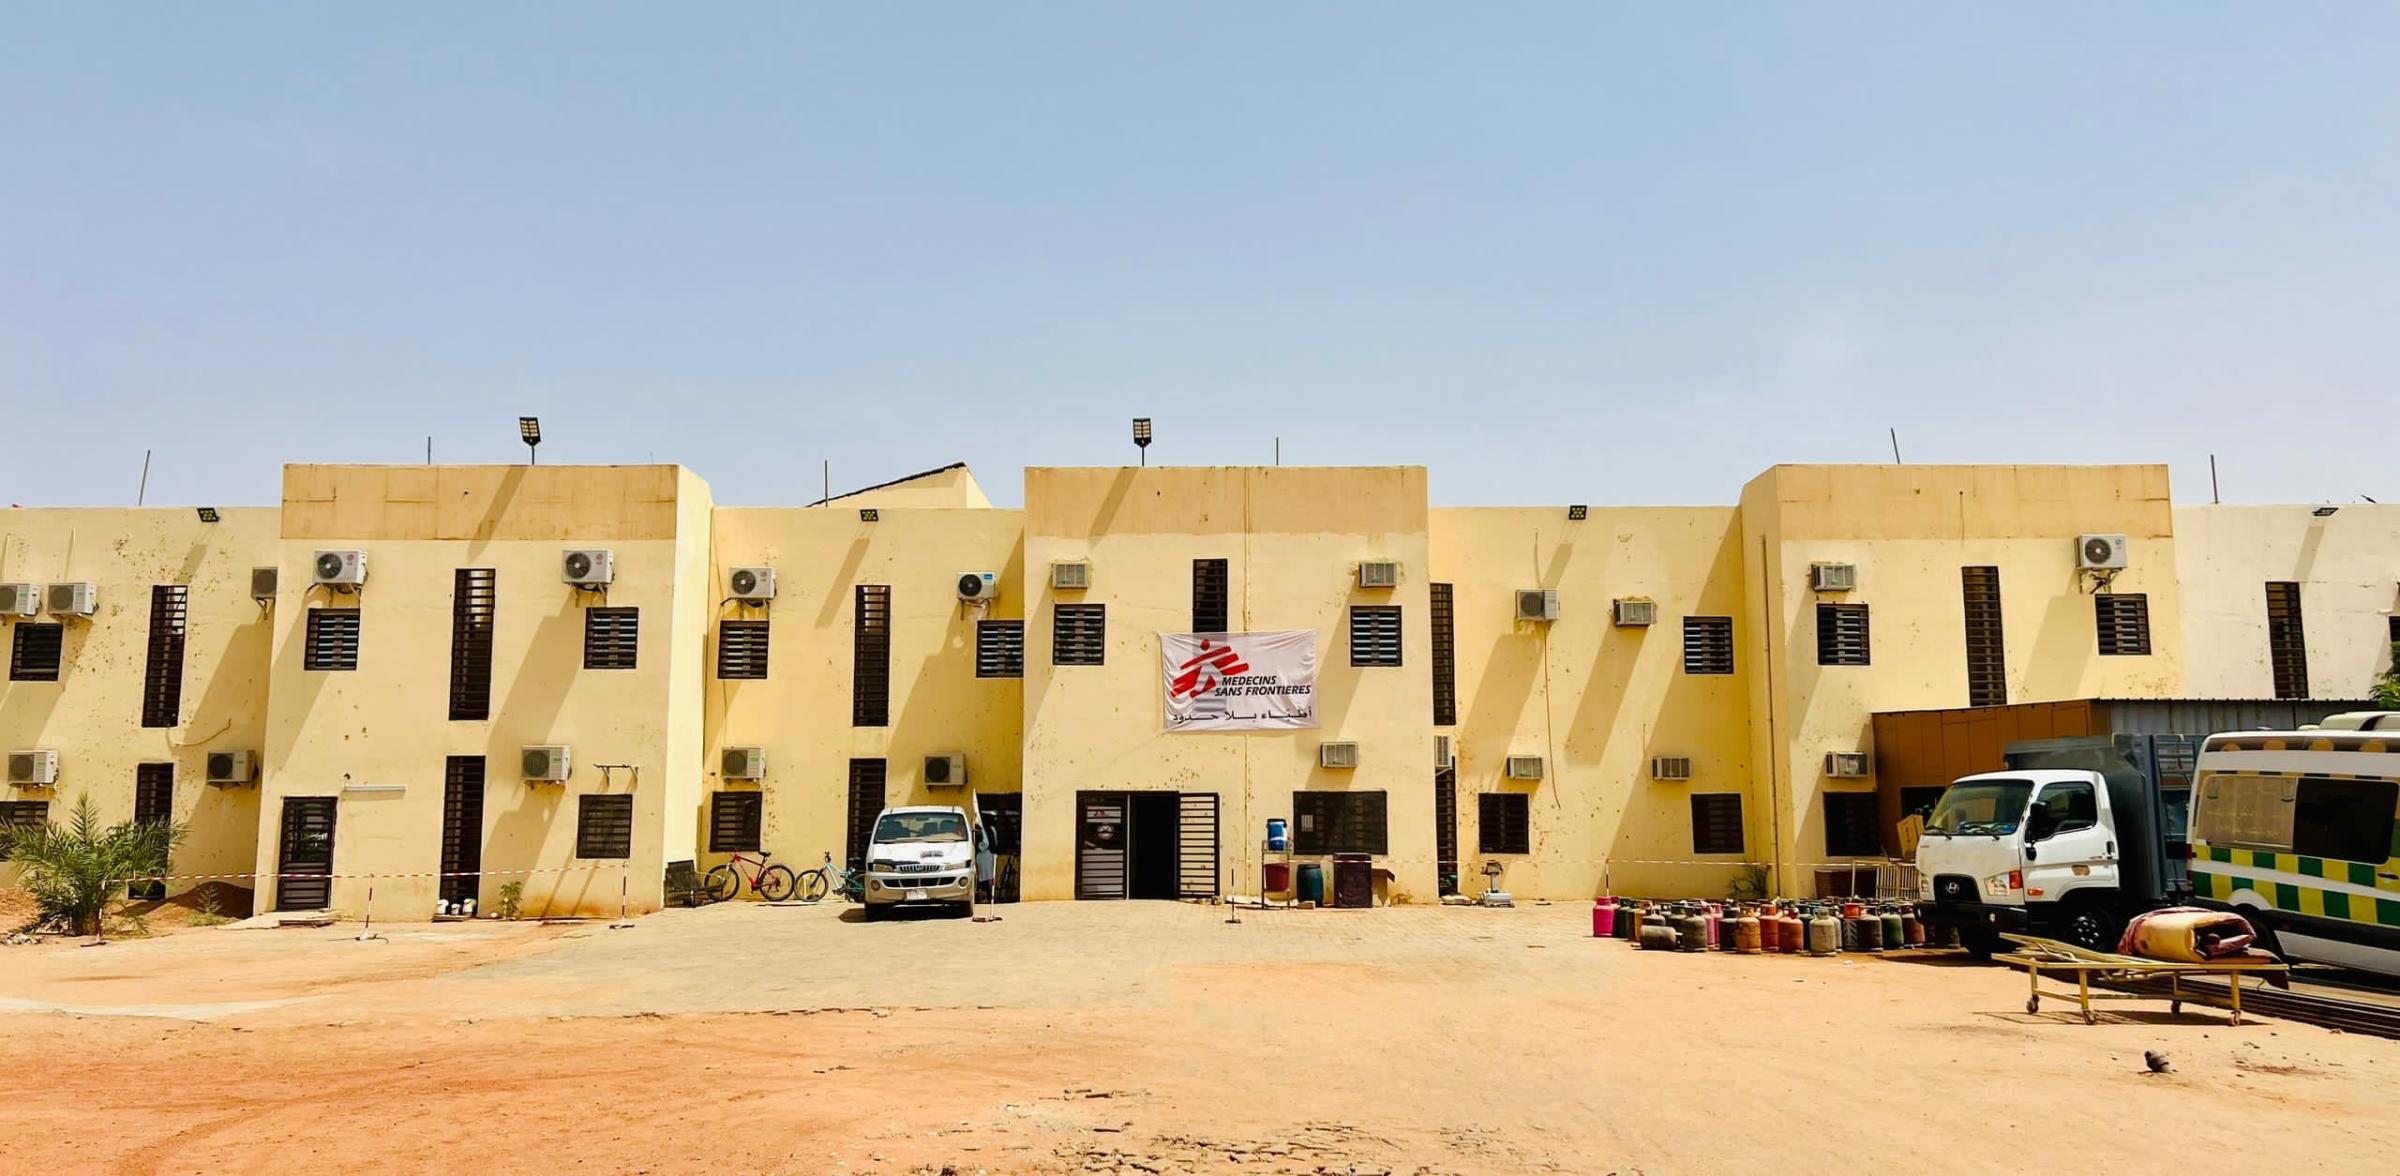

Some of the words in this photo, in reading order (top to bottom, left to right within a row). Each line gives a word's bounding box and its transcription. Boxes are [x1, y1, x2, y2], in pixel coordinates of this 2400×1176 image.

[1221, 675, 1277, 686] MEDECINS
[1214, 686, 1242, 696] SANS
[1245, 685, 1311, 696] FRONTIERES
[1173, 713, 1219, 724] حدود
[1224, 710, 1257, 723] بلا
